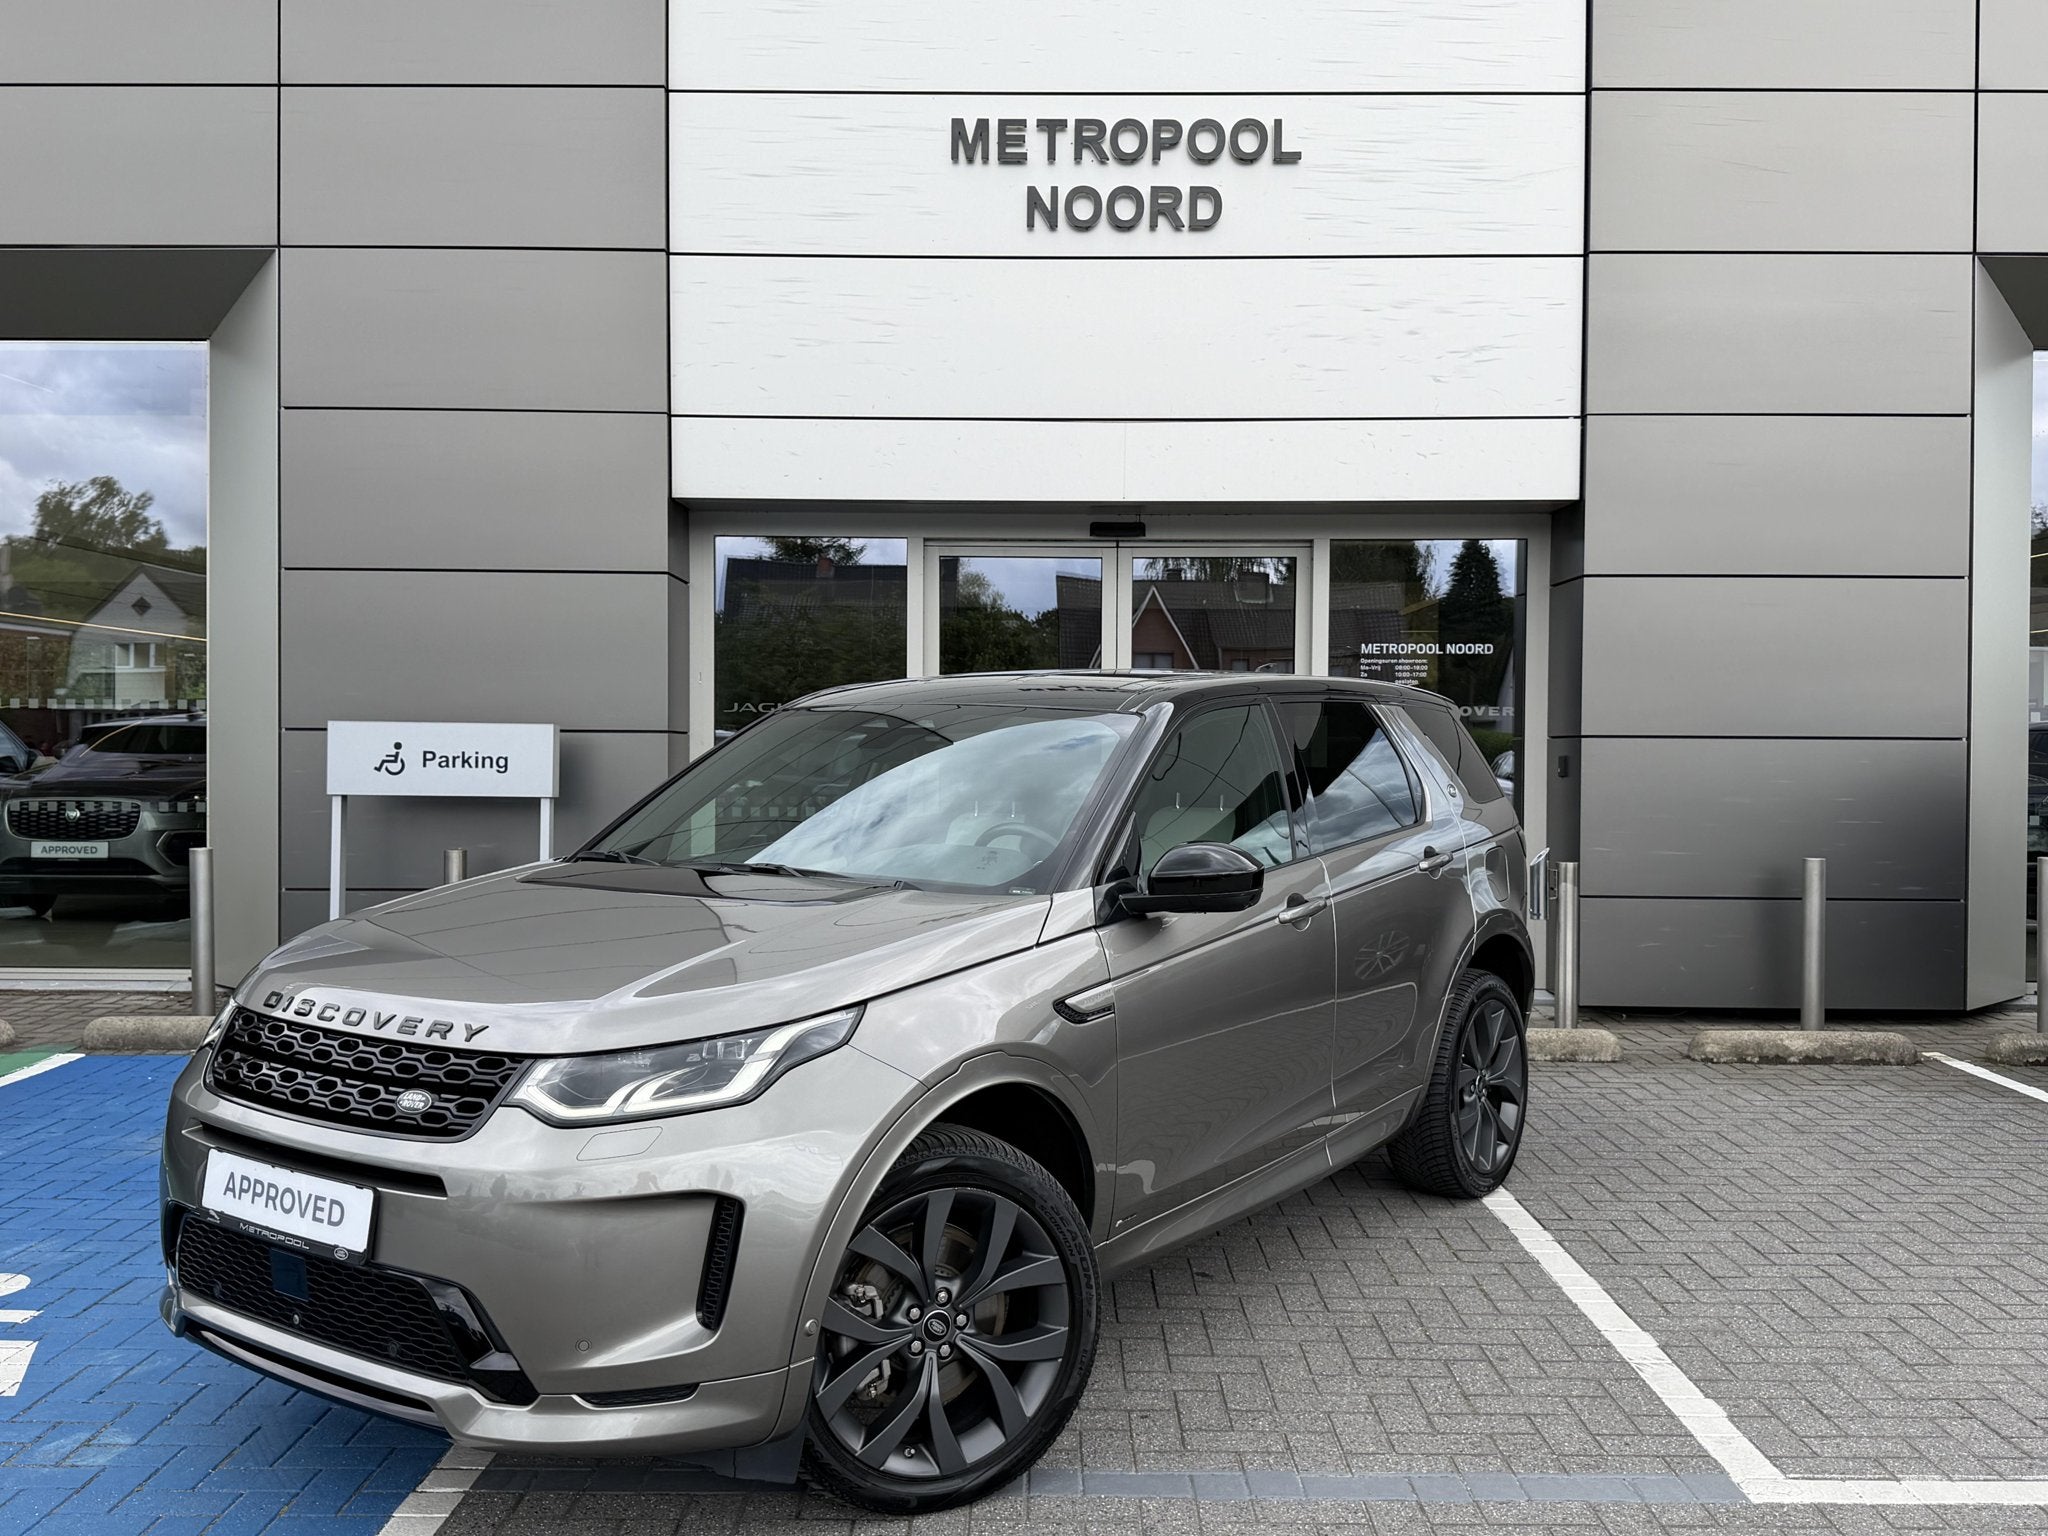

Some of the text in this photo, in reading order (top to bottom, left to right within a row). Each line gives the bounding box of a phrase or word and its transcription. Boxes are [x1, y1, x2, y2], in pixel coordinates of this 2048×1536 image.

[951, 117, 1302, 164] METROPOOL
[1026, 185, 1223, 231] NOORD
[1360, 643, 1494, 655] METROPOOL NOORD
[422, 750, 509, 774] Parking
[40, 845, 98, 855] APPROVED
[263, 991, 489, 1043] DISCOVERY
[223, 1171, 345, 1228] APPROVED
[239, 1222, 310, 1250] METROPOOL
[1038, 1204, 1076, 1258] SCORPION
